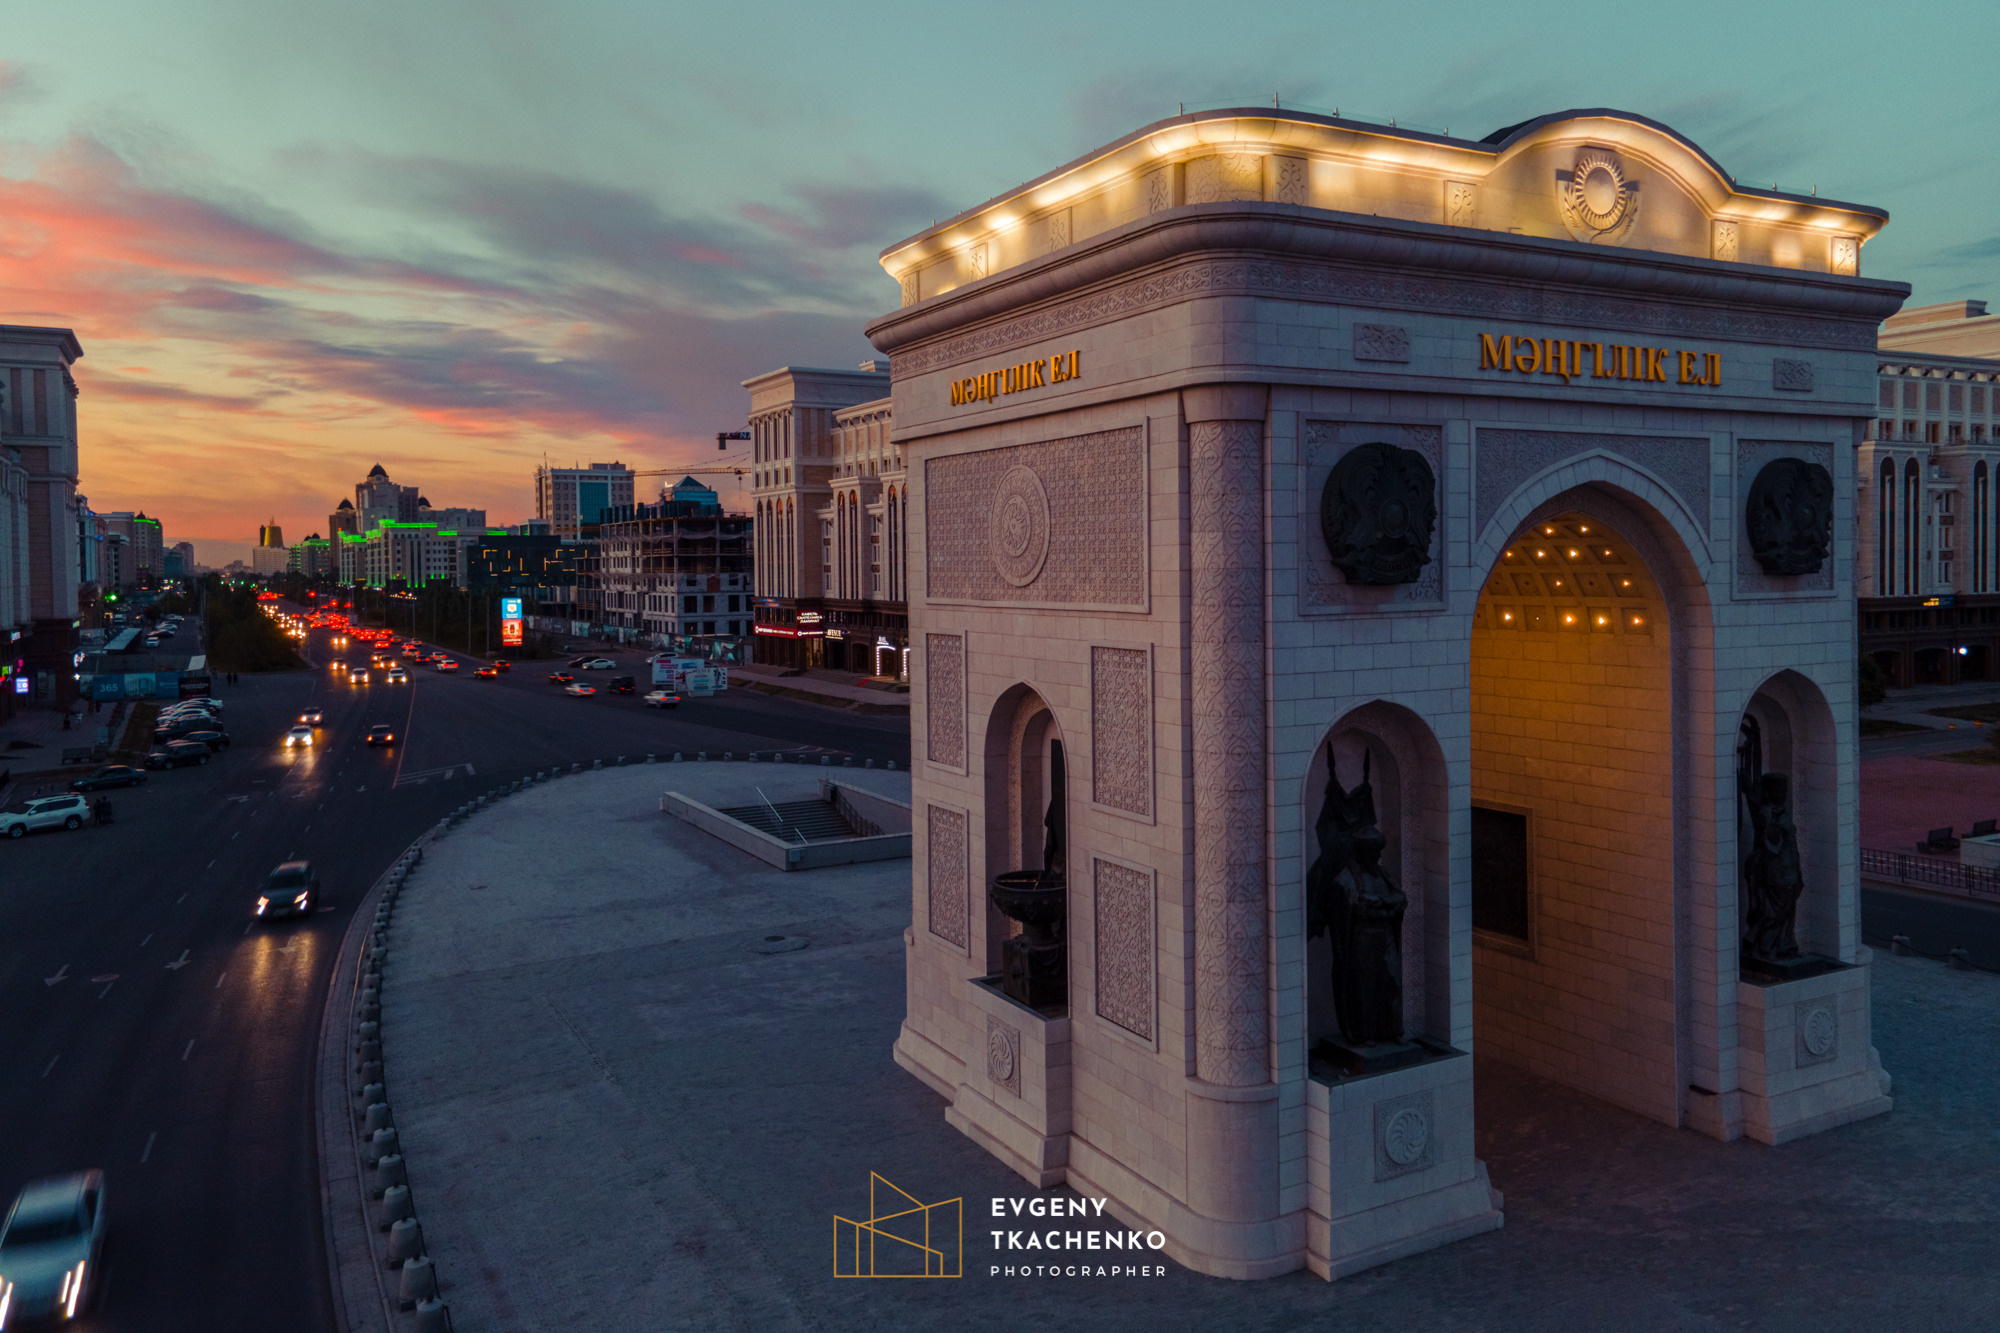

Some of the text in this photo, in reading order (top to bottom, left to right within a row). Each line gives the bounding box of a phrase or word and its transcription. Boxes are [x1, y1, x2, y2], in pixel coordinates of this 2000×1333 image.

[950, 350, 1081, 406] МӘҢГІЛІК ЕЛ
[1478, 333, 1722, 386] МӘҢГІЛІК ЕЛ
[99, 683, 119, 692] 365
